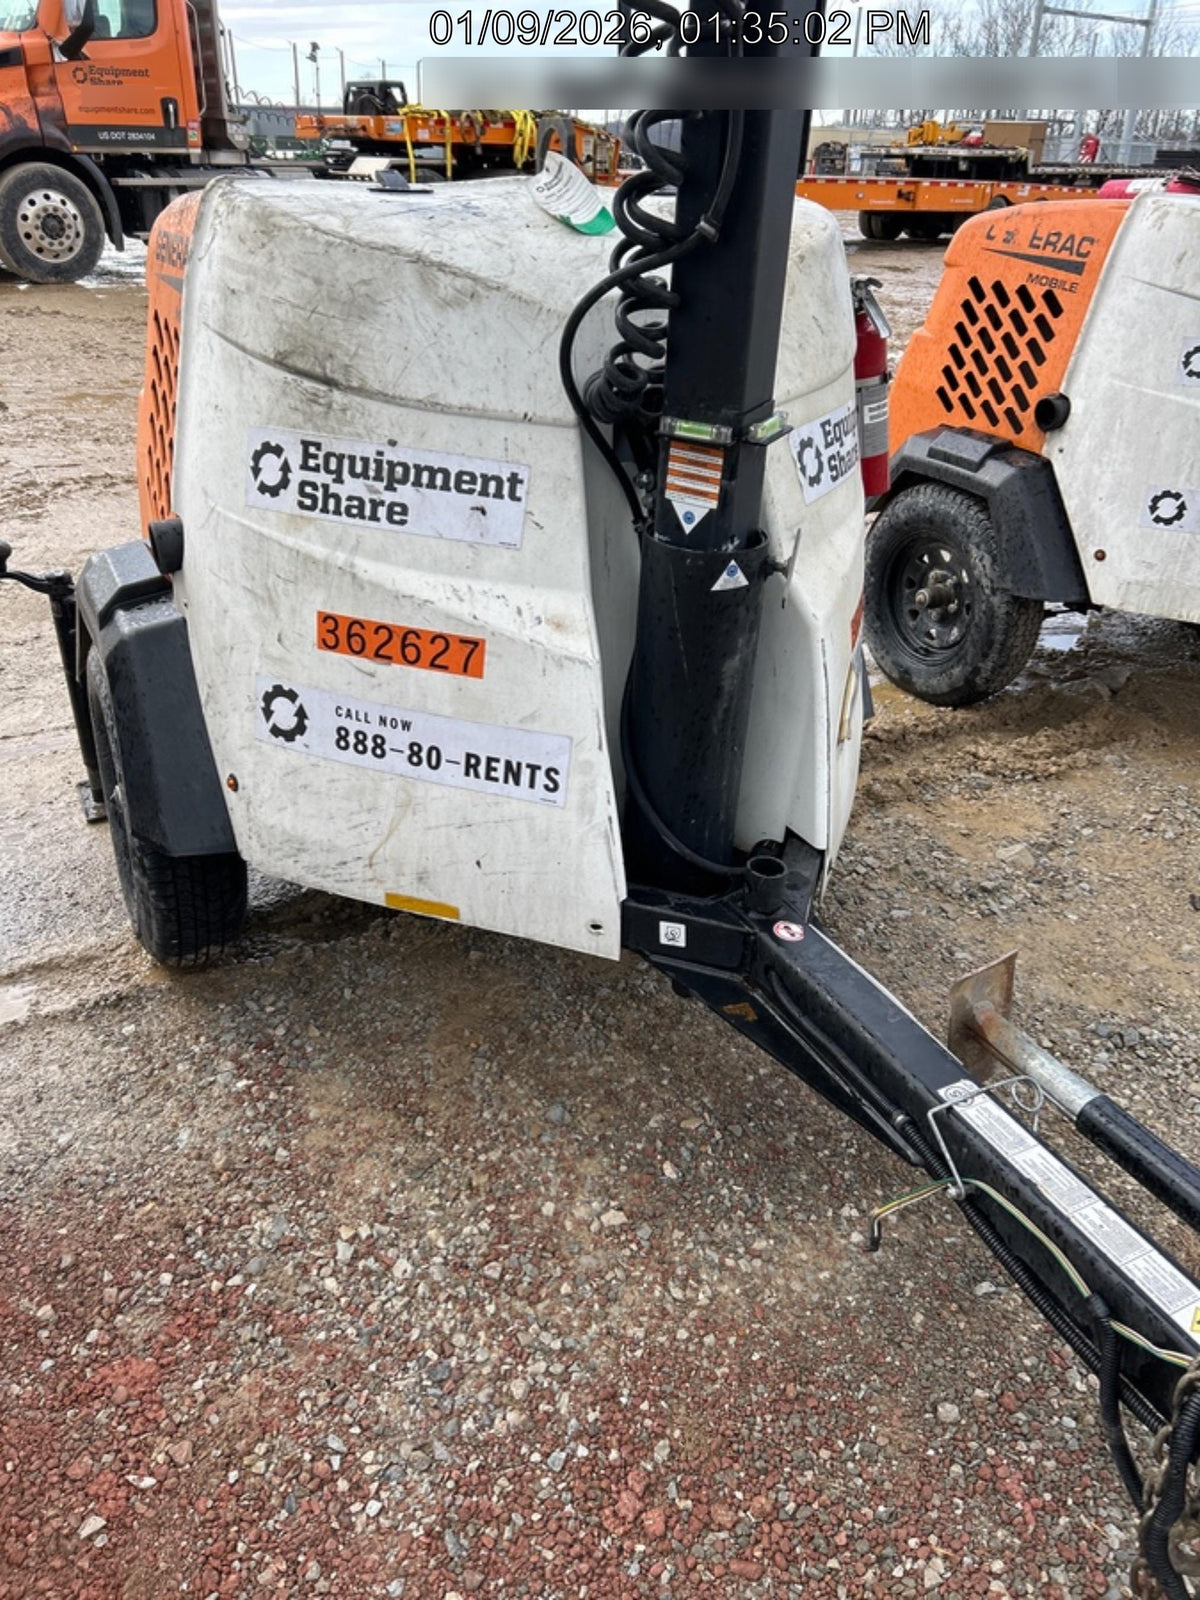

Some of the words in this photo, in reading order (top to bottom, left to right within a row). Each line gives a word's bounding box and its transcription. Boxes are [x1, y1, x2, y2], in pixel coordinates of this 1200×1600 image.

[88, 65, 150, 78] Equipment
[1026, 273, 1080, 294] MOBILE
[299, 439, 524, 503] Equipment
[297, 480, 410, 527] Share
[321, 614, 480, 674] 362627
[335, 705, 372, 725] CALL
[378, 715, 413, 733] NOW
[335, 726, 561, 794] 888-80-RENTS
